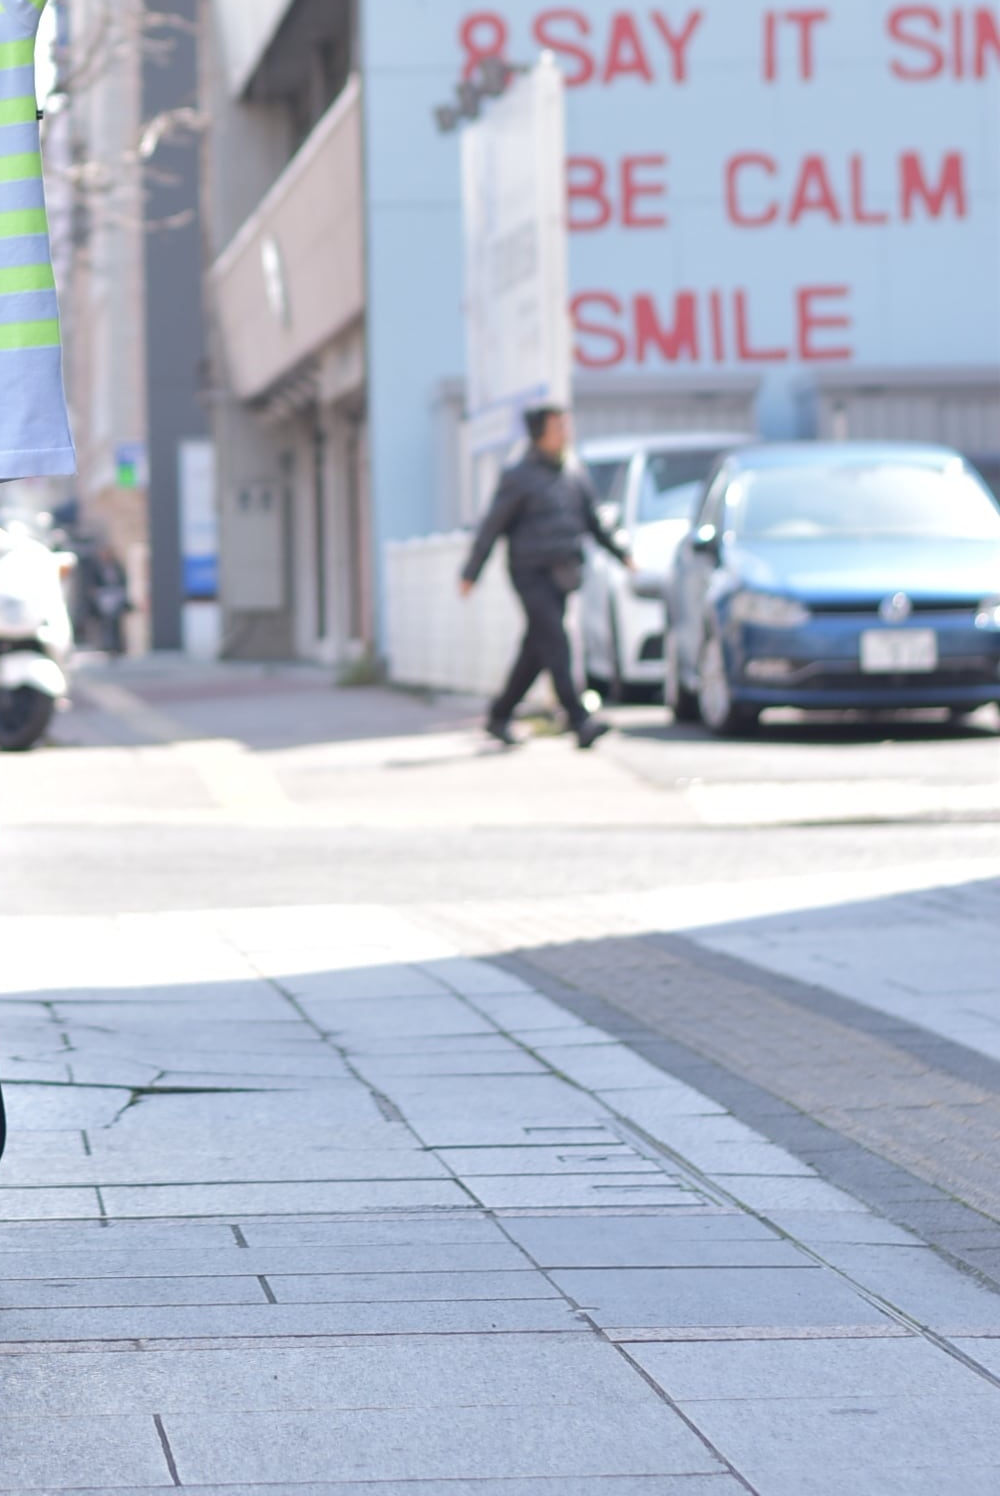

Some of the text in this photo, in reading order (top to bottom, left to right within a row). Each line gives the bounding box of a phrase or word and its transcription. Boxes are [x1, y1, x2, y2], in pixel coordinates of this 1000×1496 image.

[761, 7, 829, 83] IT
[563, 150, 968, 233] BE CALM
[567, 285, 851, 371] SMILE
